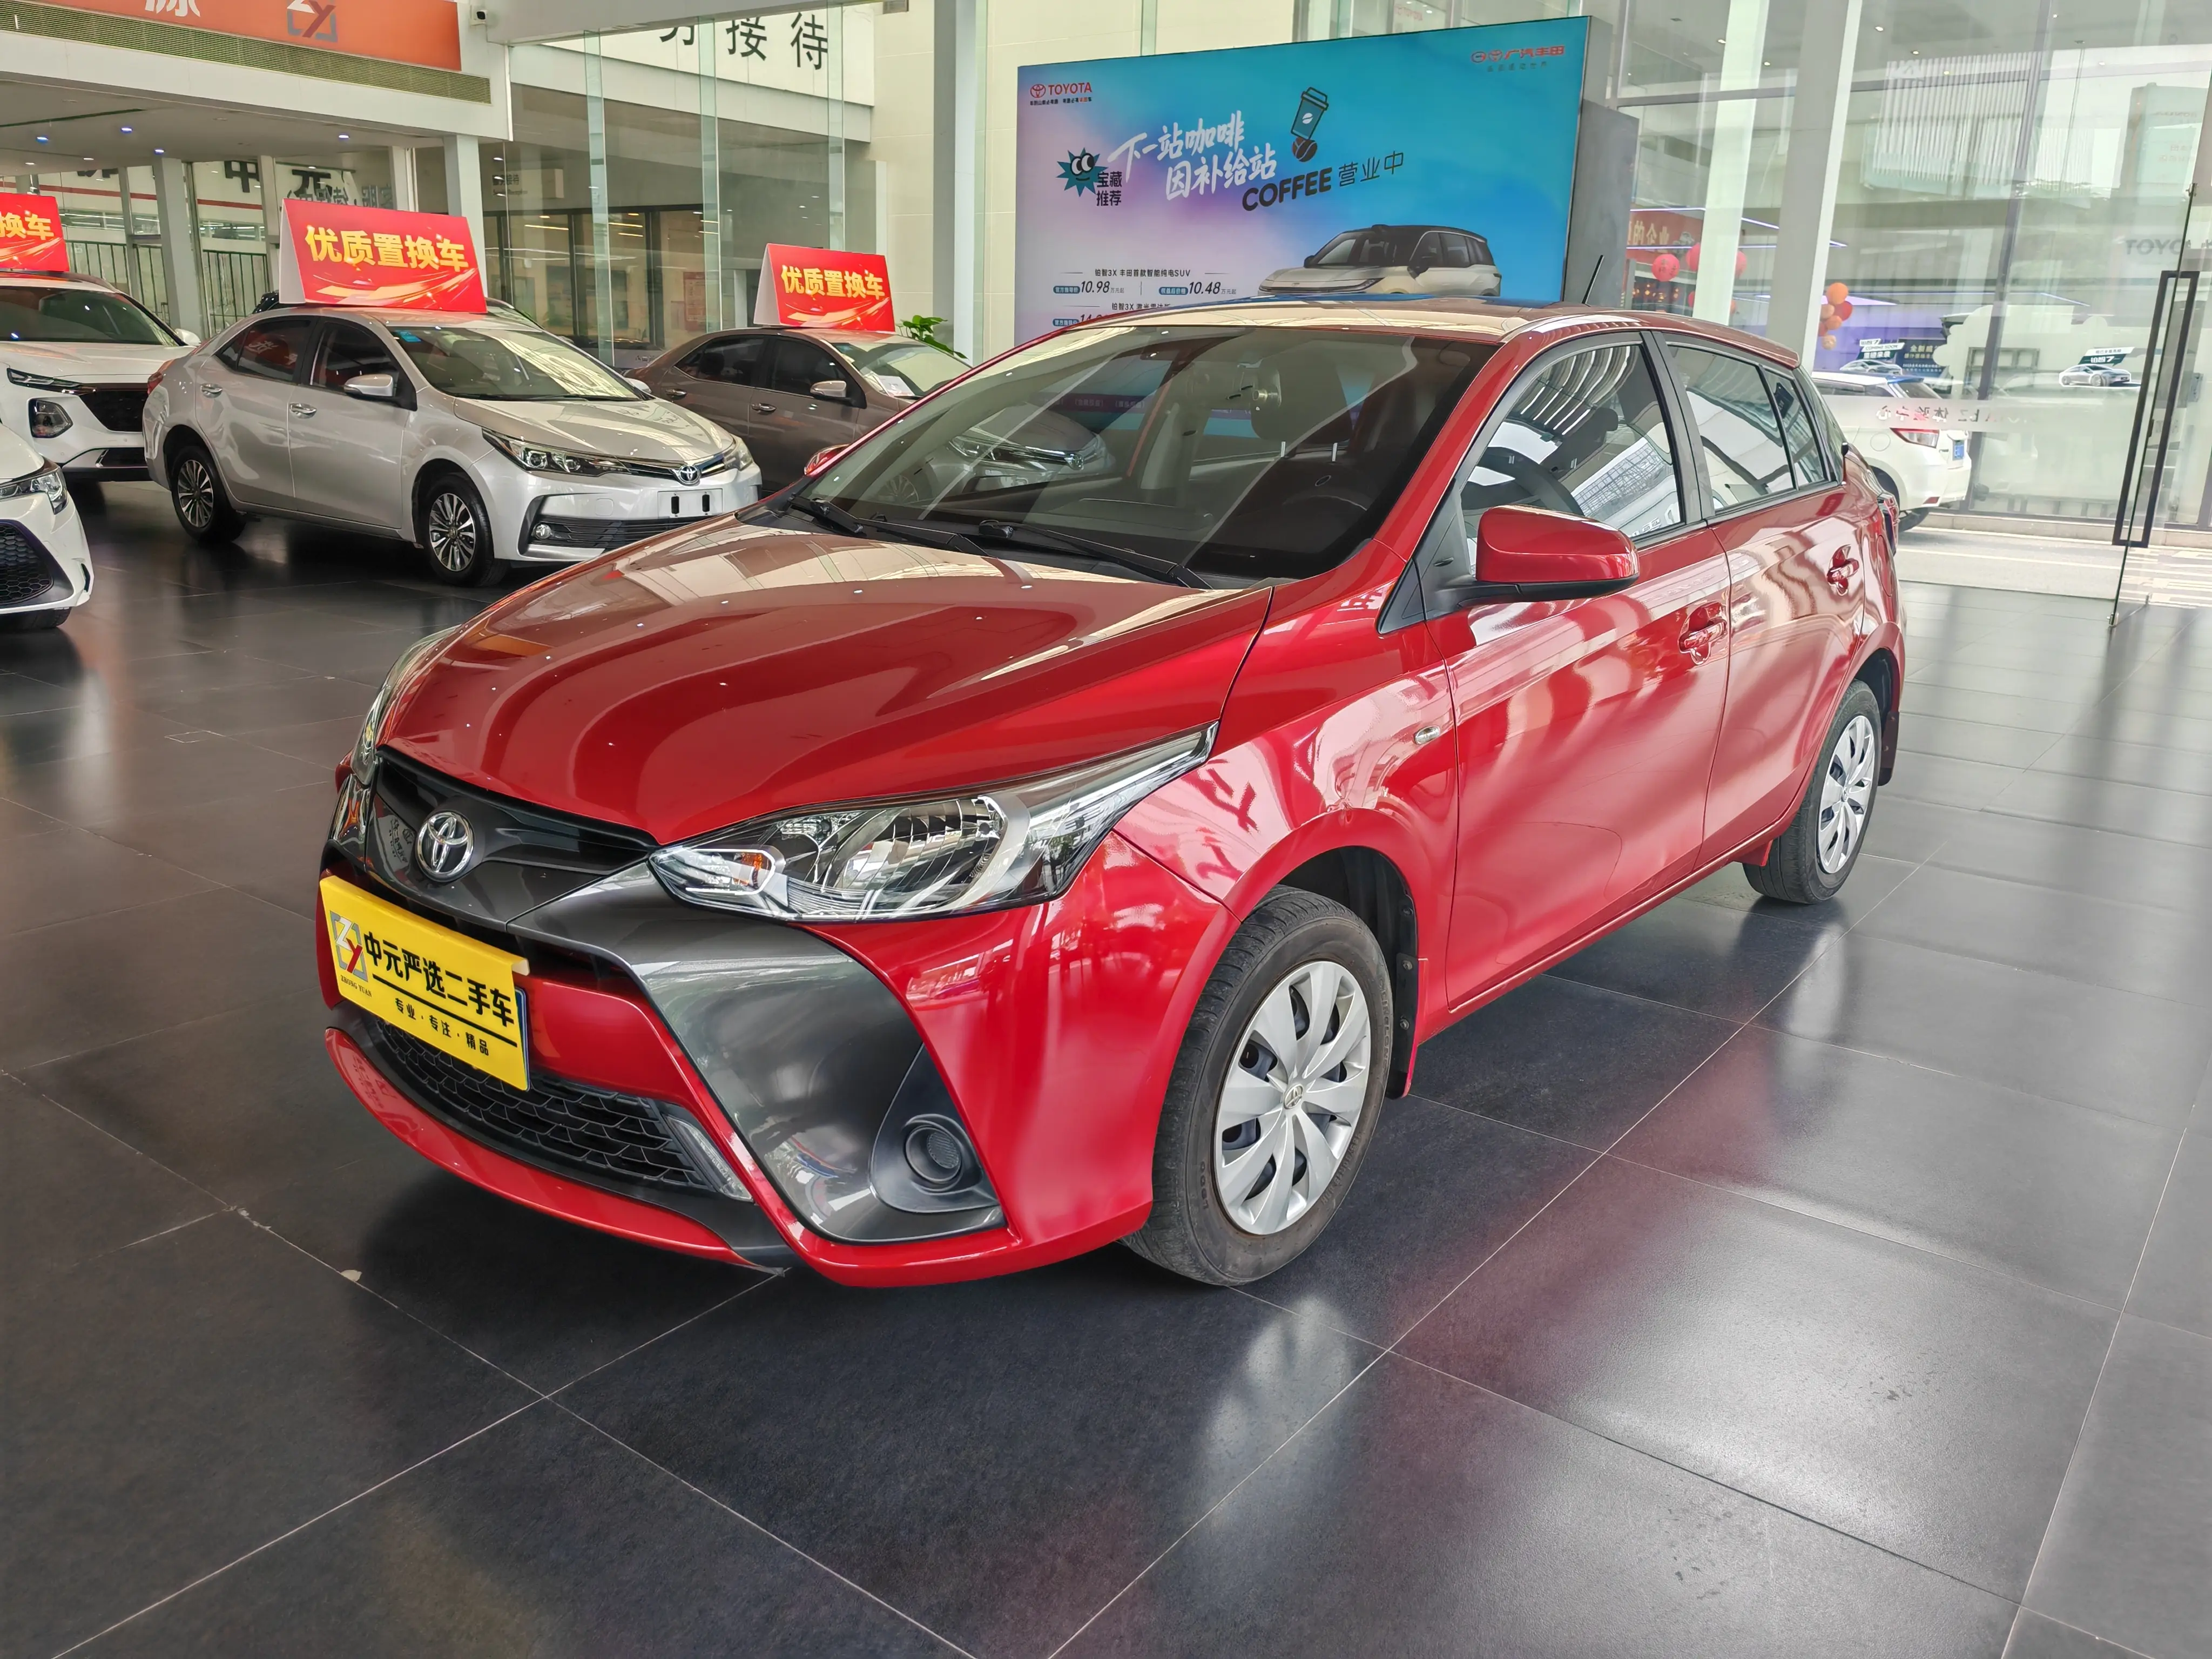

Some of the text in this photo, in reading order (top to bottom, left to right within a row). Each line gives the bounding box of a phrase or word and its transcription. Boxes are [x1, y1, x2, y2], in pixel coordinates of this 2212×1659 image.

[1504, 45, 1565, 60] 广汽丰田
[1048, 82, 1092, 95] TOYOTA
[1107, 110, 1245, 183] 下一站咖啡
[1096, 171, 1122, 188] 宝藏
[1166, 142, 1277, 201] 因补给站
[1338, 151, 1404, 187] 营业中
[1096, 190, 1122, 207] 推荐
[1242, 167, 1332, 211] COFFEE
[305, 226, 469, 272] 优质置换车
[780, 265, 886, 301] 优质置换车
[1081, 280, 1110, 293] 10.98
[1189, 281, 1221, 294] 10.48
[363, 931, 515, 1028] 中元严选二手车
[395, 997, 490, 1056] 专业·专注·精品
